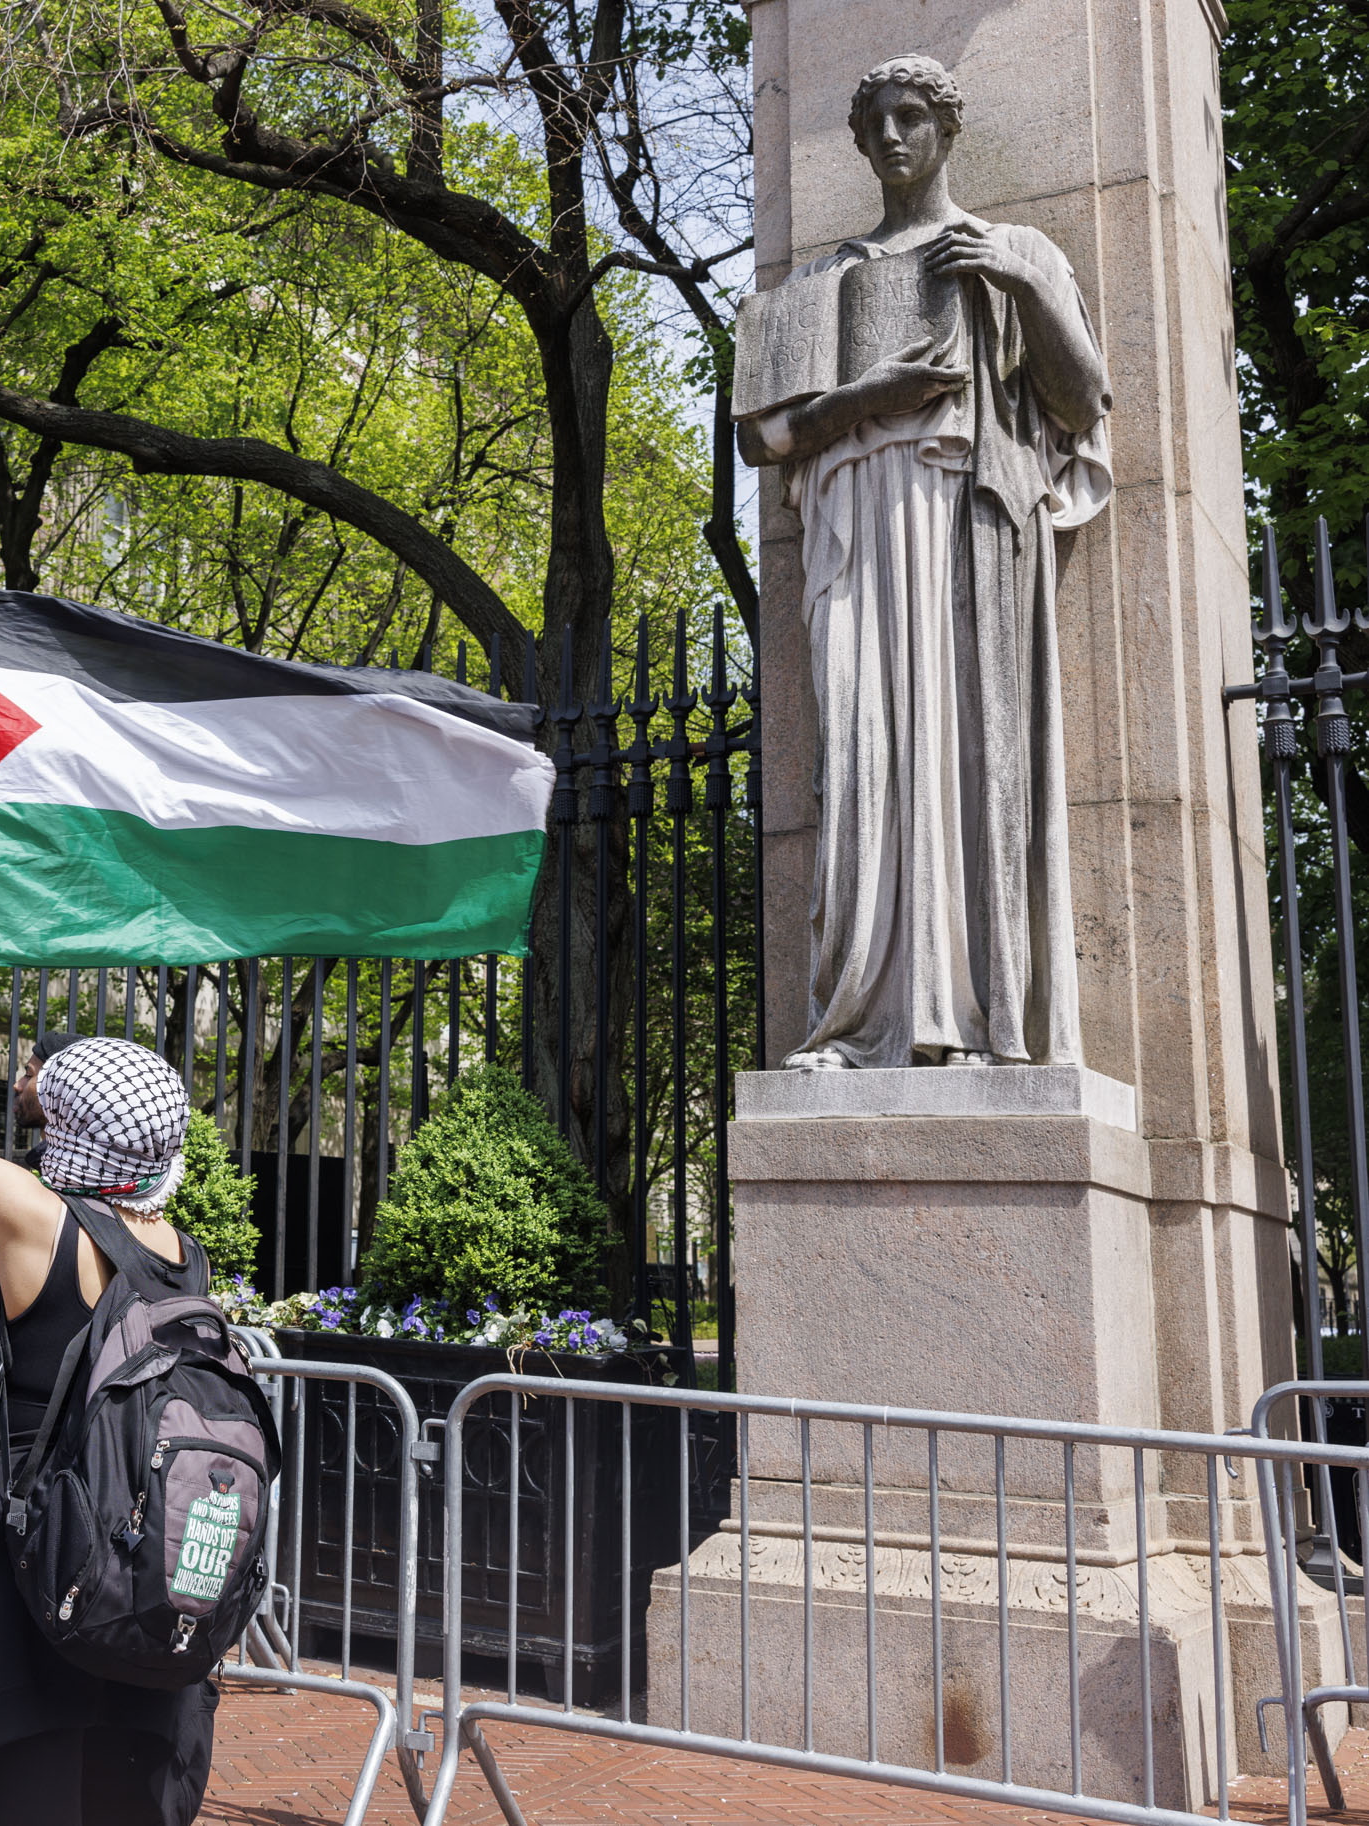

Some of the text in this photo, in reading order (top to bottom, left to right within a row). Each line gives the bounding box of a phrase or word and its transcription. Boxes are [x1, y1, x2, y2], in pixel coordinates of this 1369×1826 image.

[191, 1501, 208, 1518] AND
[186, 1518, 237, 1549] HANDS OFF
[181, 1540, 232, 1577] OUR
